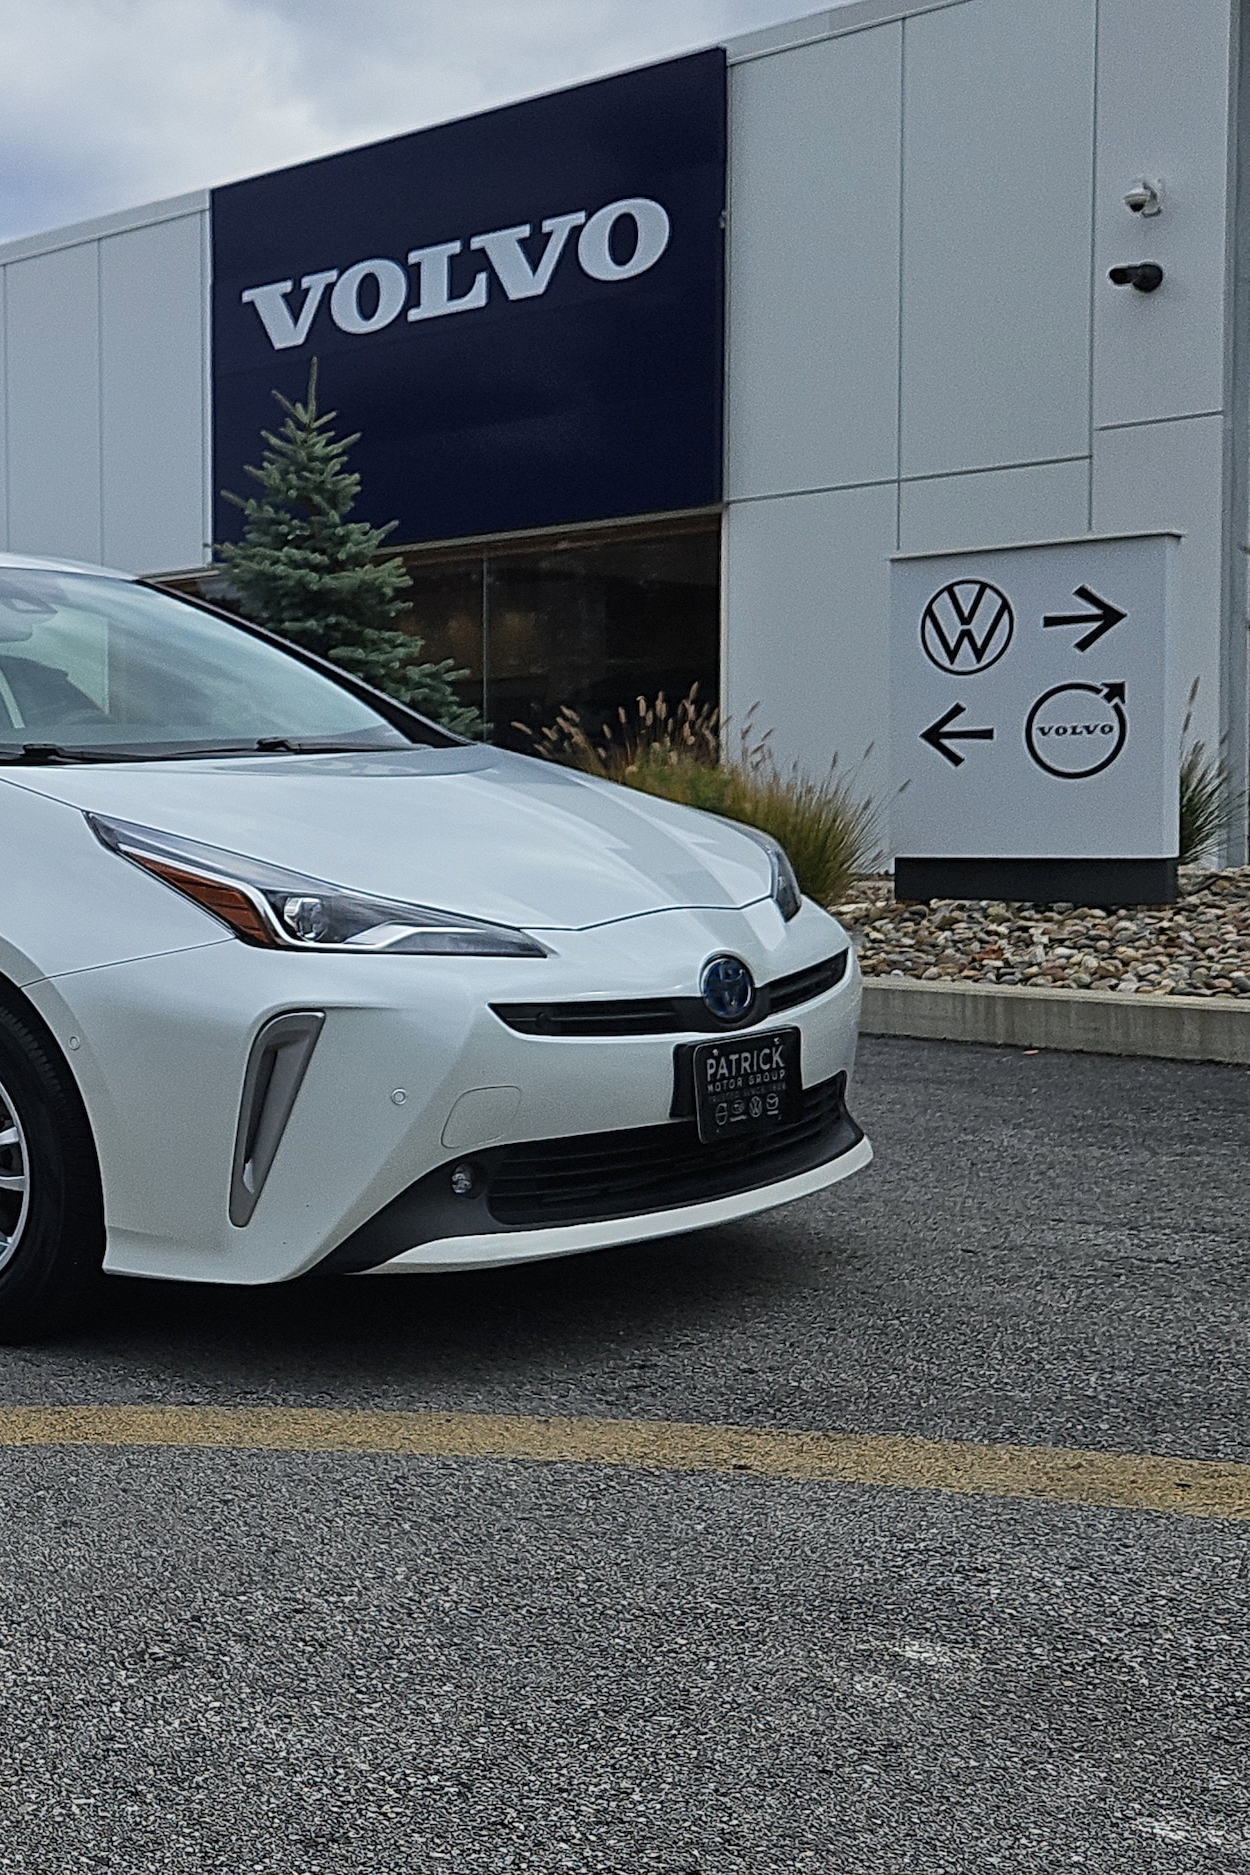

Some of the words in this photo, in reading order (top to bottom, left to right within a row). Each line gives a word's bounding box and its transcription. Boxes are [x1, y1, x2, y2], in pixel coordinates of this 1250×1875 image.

[242, 197, 670, 350] VOLVO
[1036, 723, 1114, 737] VOLVO
[706, 1045, 785, 1082] PATRICK
[707, 1076, 743, 1093] MOTOR
[748, 1069, 786, 1086] GROUP
